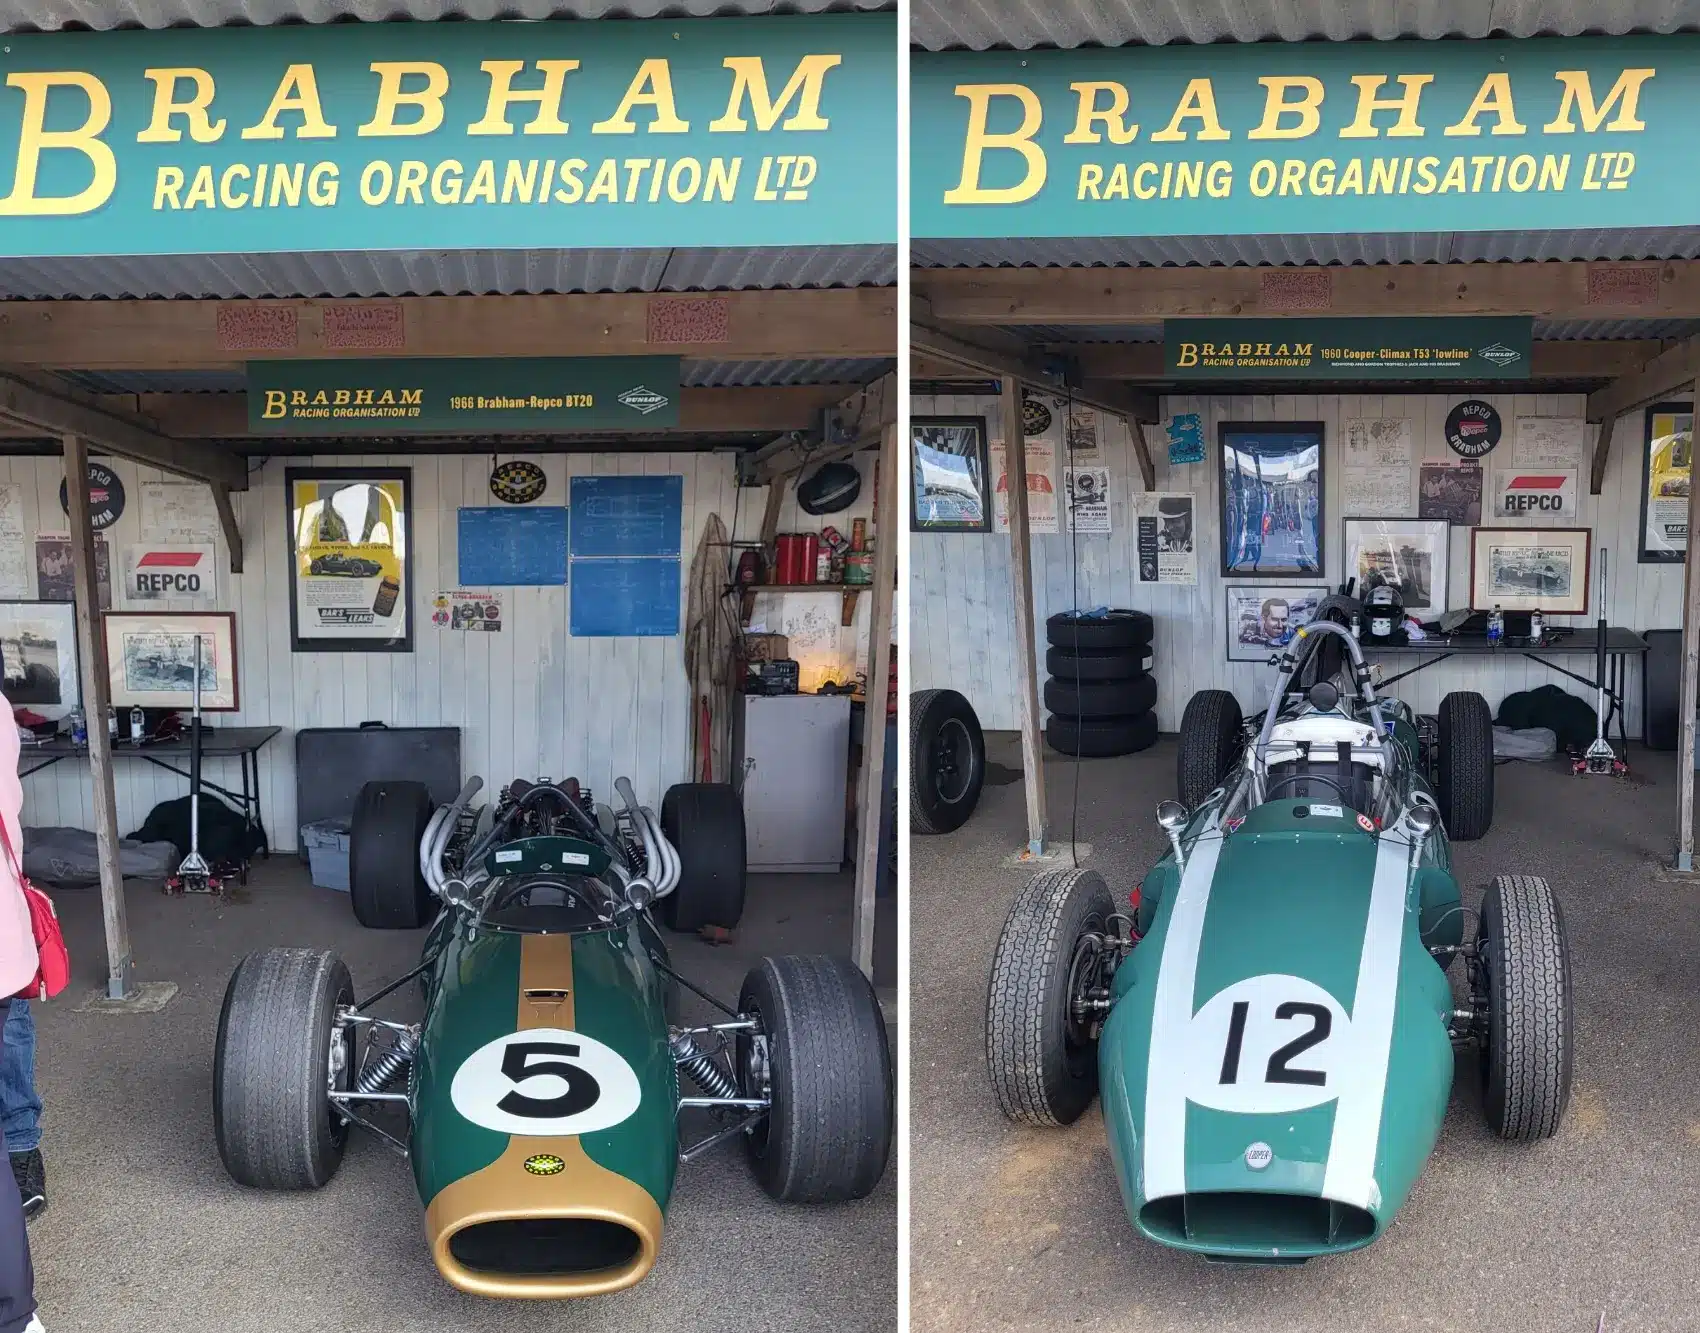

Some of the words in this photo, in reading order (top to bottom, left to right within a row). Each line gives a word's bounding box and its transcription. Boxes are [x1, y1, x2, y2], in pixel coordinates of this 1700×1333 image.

[0, 54, 841, 216] BRABHAM
[943, 68, 1656, 204] BRABHAM
[154, 162, 338, 209] RACING
[361, 158, 740, 205] ORGANISATION
[756, 156, 816, 200] LTD
[1078, 162, 1232, 200] RACING
[1250, 155, 1569, 196] ORGANISATION
[1582, 152, 1635, 190] LTD
[1177, 343, 1313, 367] BRABHAM
[1203, 358, 1234, 366] RACING
[1237, 358, 1299, 366] ORGANISATION
[1301, 358, 1311, 366] LTD
[1320, 348, 1341, 359] 1960
[1343, 348, 1411, 361] Cooper-Climax
[1413, 348, 1430, 359] T53
[262, 389, 424, 418] BRABHAM
[450, 396, 474, 409] 1966
[477, 396, 563, 410] Brabham-Repco
[566, 395, 593, 408] BT20
[293, 408, 330, 418] RACING
[333, 407, 406, 417] ORGANISATION
[408, 407, 421, 417] LTD
[1462, 405, 1491, 420] REPCO
[1450, 434, 1491, 454] BRABHAM
[88, 469, 112, 486] PCO
[1505, 494, 1563, 511] REPCO
[1667, 525, 1687, 533] BAR'S
[136, 573, 201, 592] REPCO
[321, 608, 345, 617] BAR'S
[348, 614, 374, 623] LEAKS
[1218, 1001, 1333, 1086] 12
[496, 1041, 601, 1119] 5
